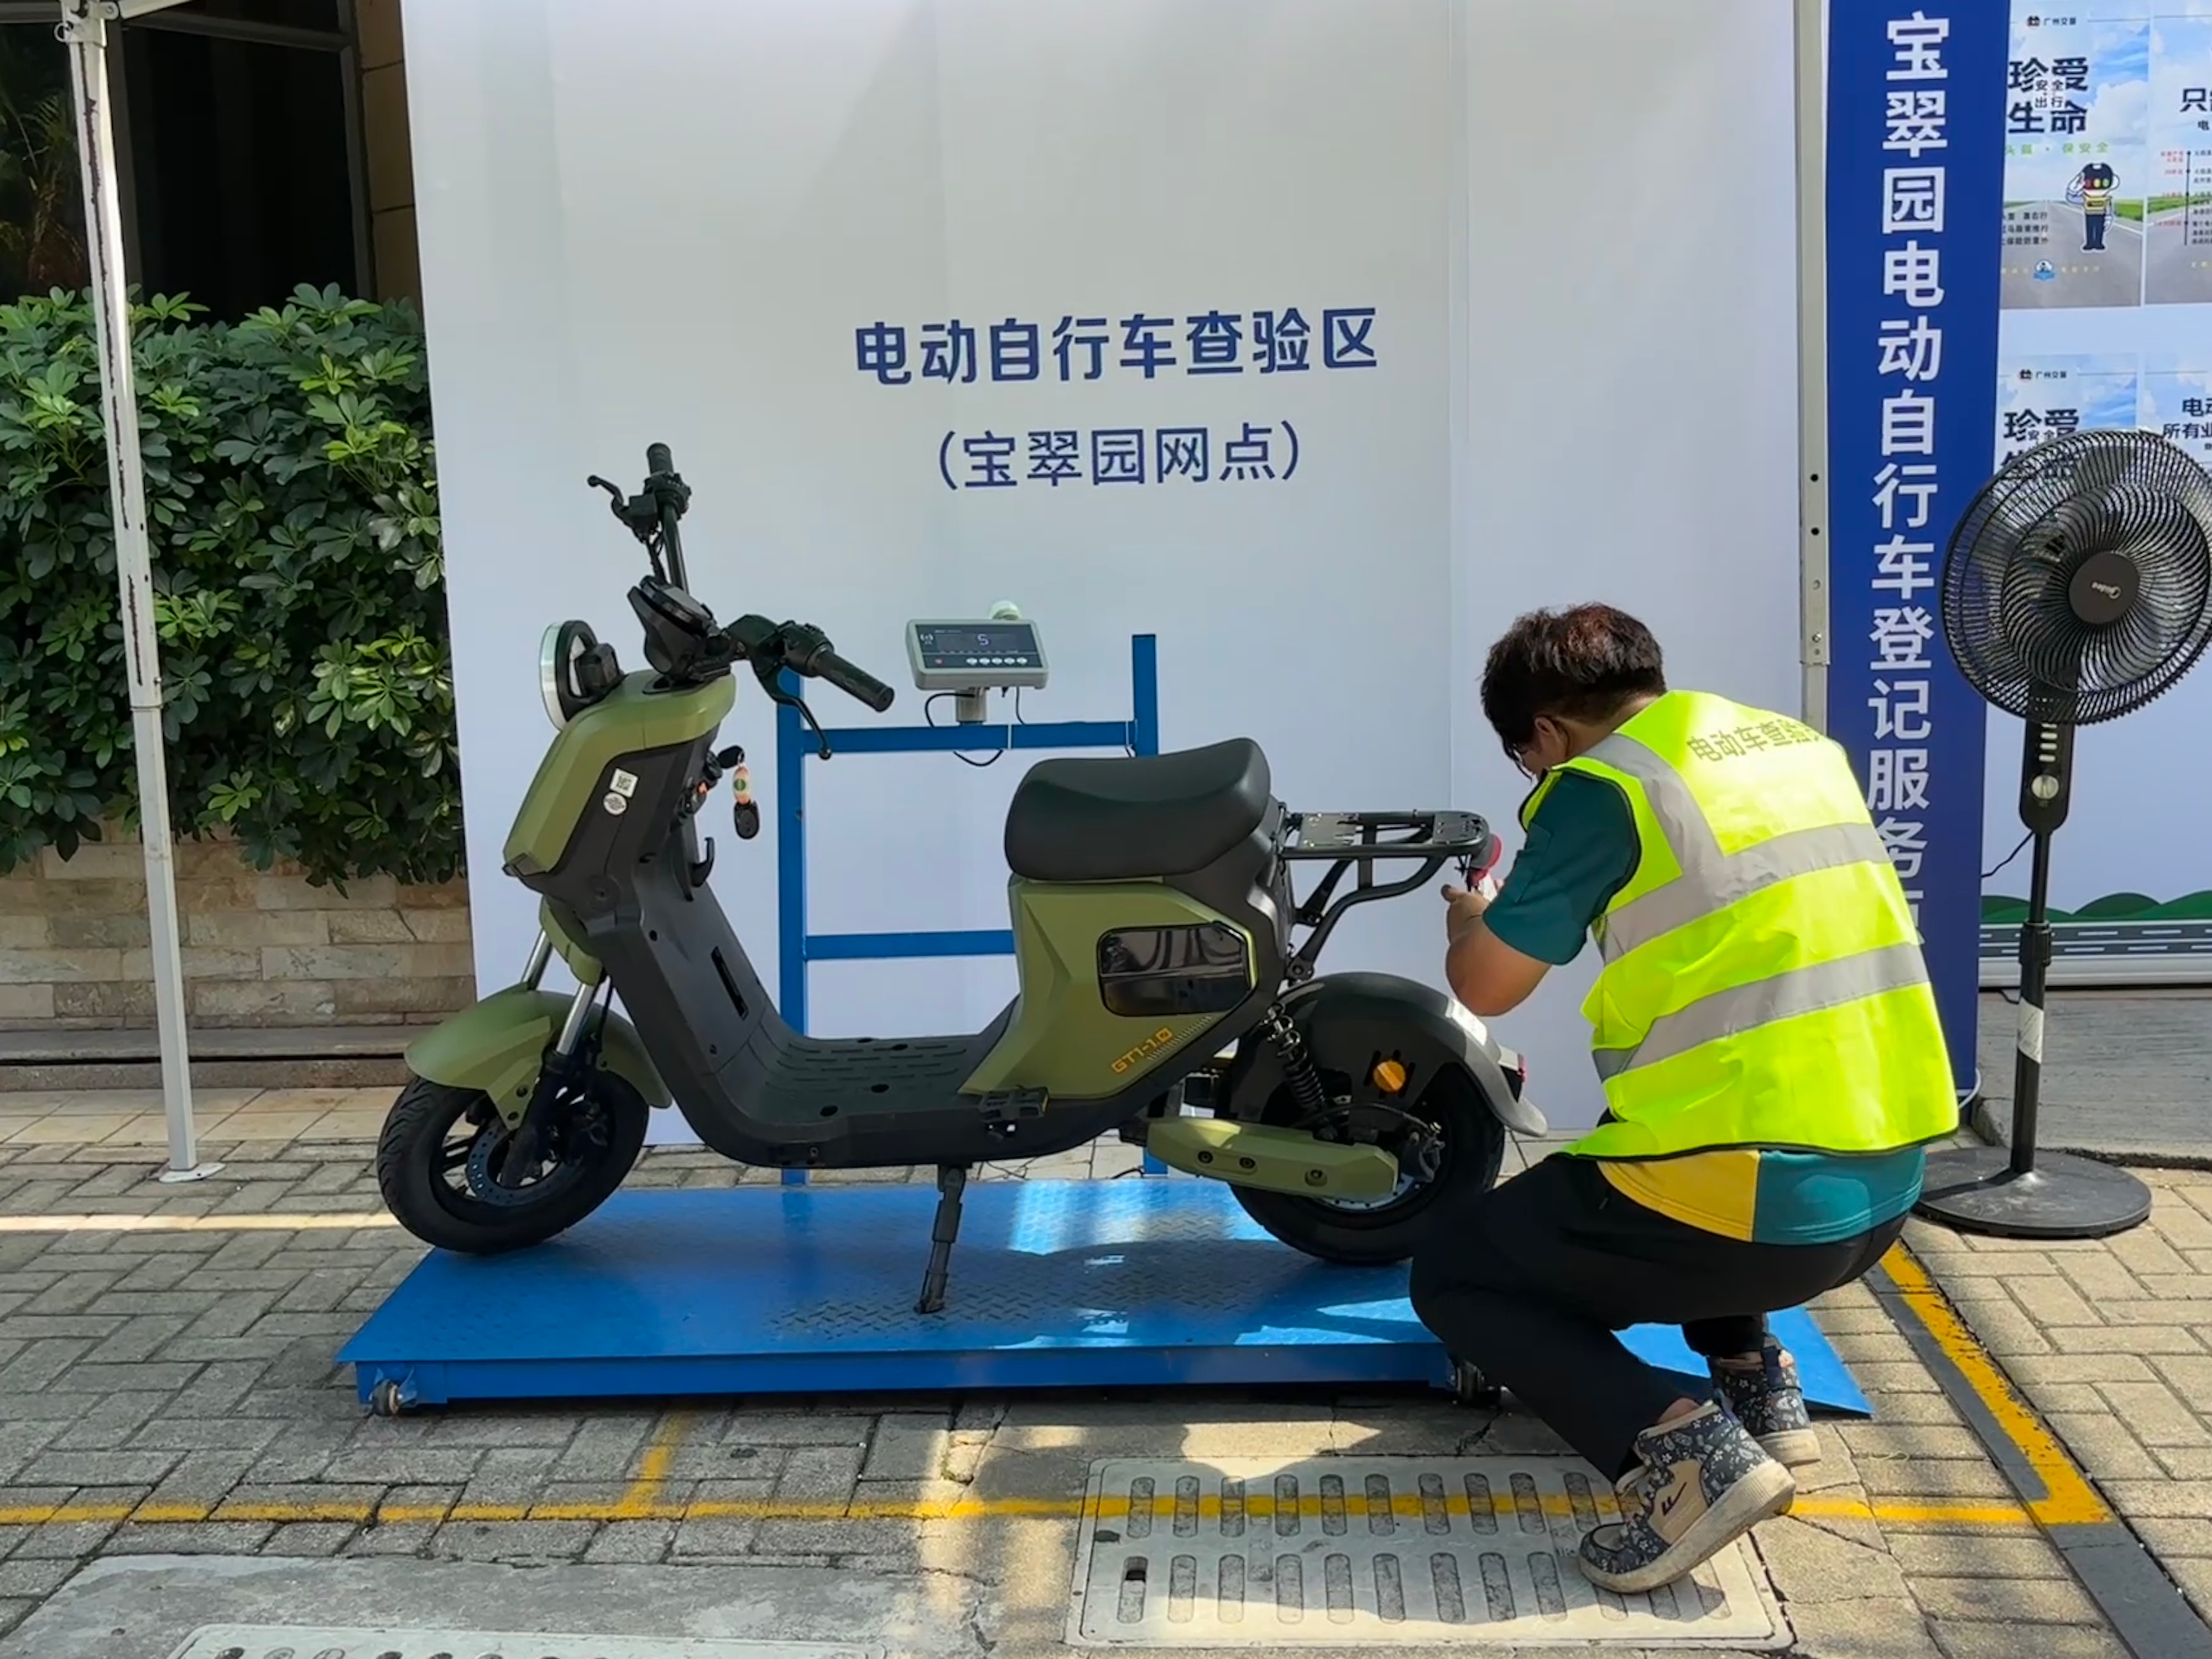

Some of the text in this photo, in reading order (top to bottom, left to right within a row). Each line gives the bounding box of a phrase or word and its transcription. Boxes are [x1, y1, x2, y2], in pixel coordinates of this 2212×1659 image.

[2008, 57, 2088, 92] 珍爱
[2179, 87, 2212, 113] 只
[2008, 101, 2088, 134] 生命
[854, 307, 1378, 385] 电动自行车查验区
[939, 420, 1299, 491] （宝翠园网点）
[1866, 11, 1949, 945] 宝翠园电动自行车登记服务
